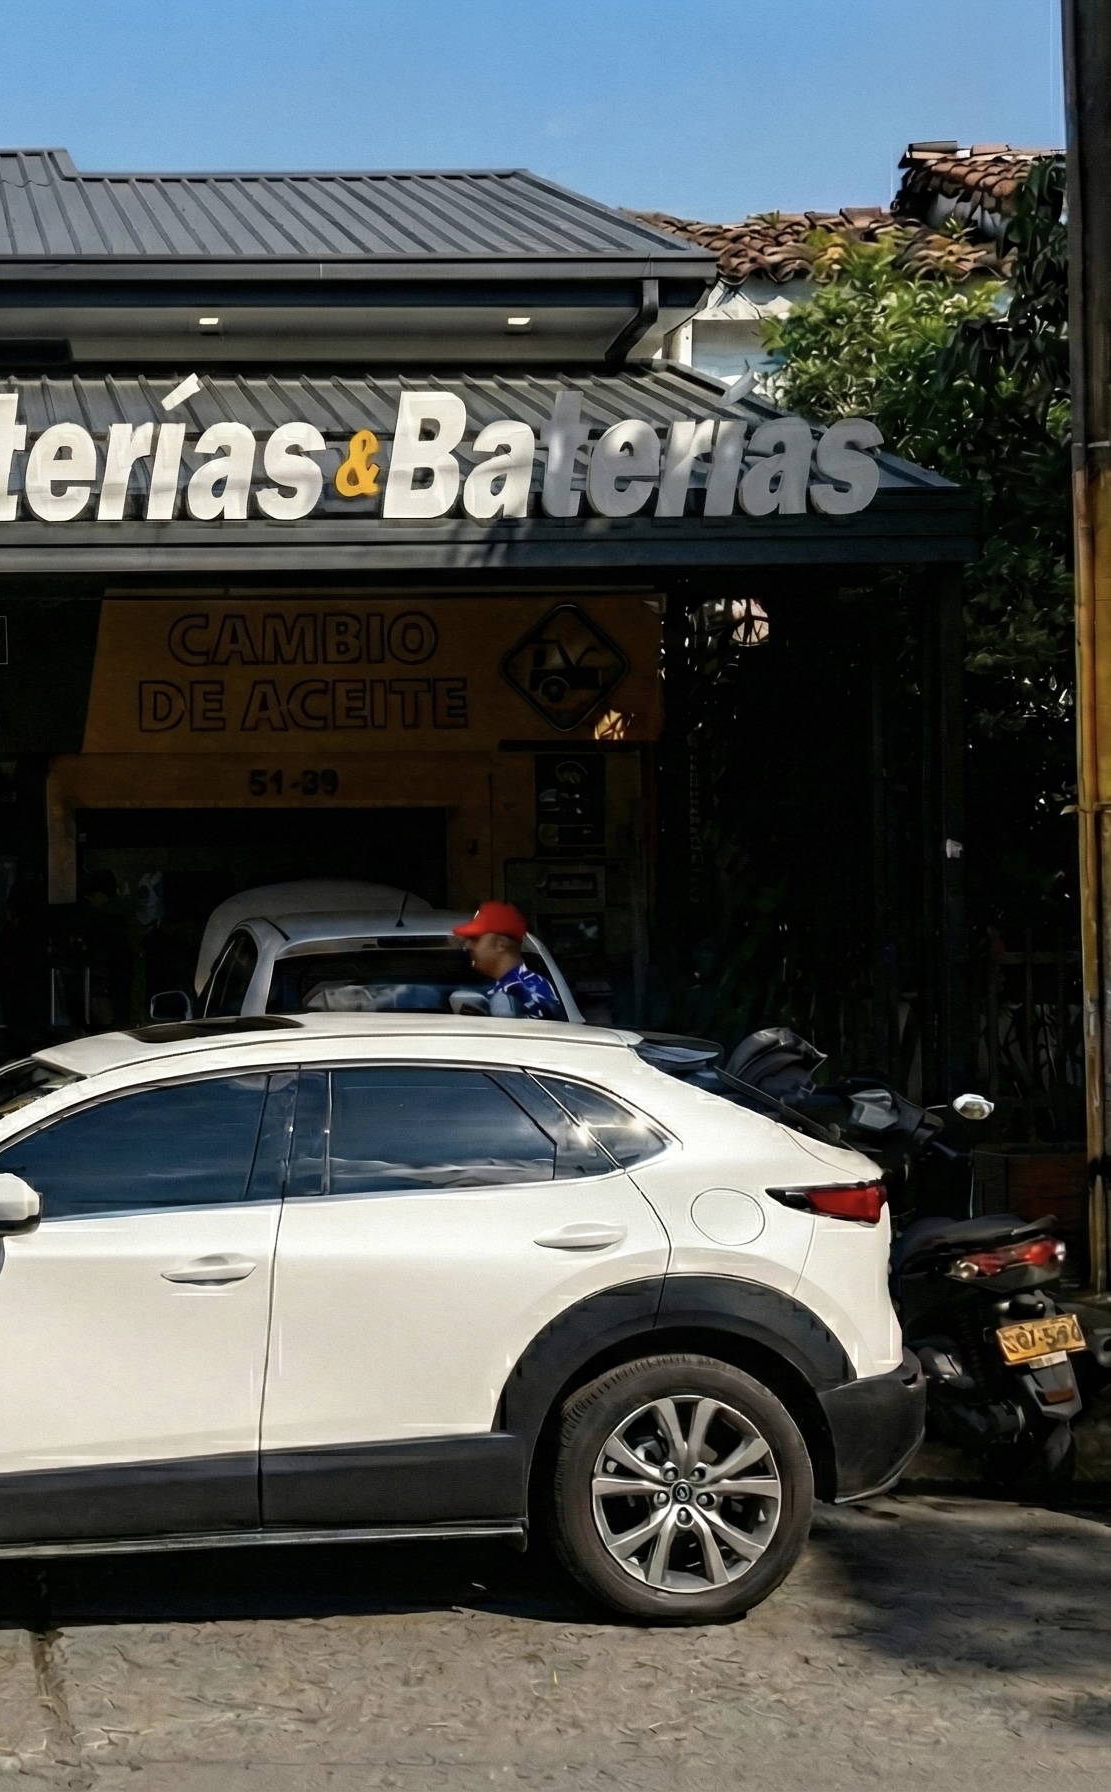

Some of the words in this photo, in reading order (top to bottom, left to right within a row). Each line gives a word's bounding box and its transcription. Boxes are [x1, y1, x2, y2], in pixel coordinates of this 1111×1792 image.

[335, 429, 381, 498] &
[383, 358, 882, 520] Baterías
[167, 611, 439, 666] CAMBIO
[139, 680, 225, 732] DE
[240, 677, 468, 732] ACEITE
[249, 769, 339, 796] 51-39
